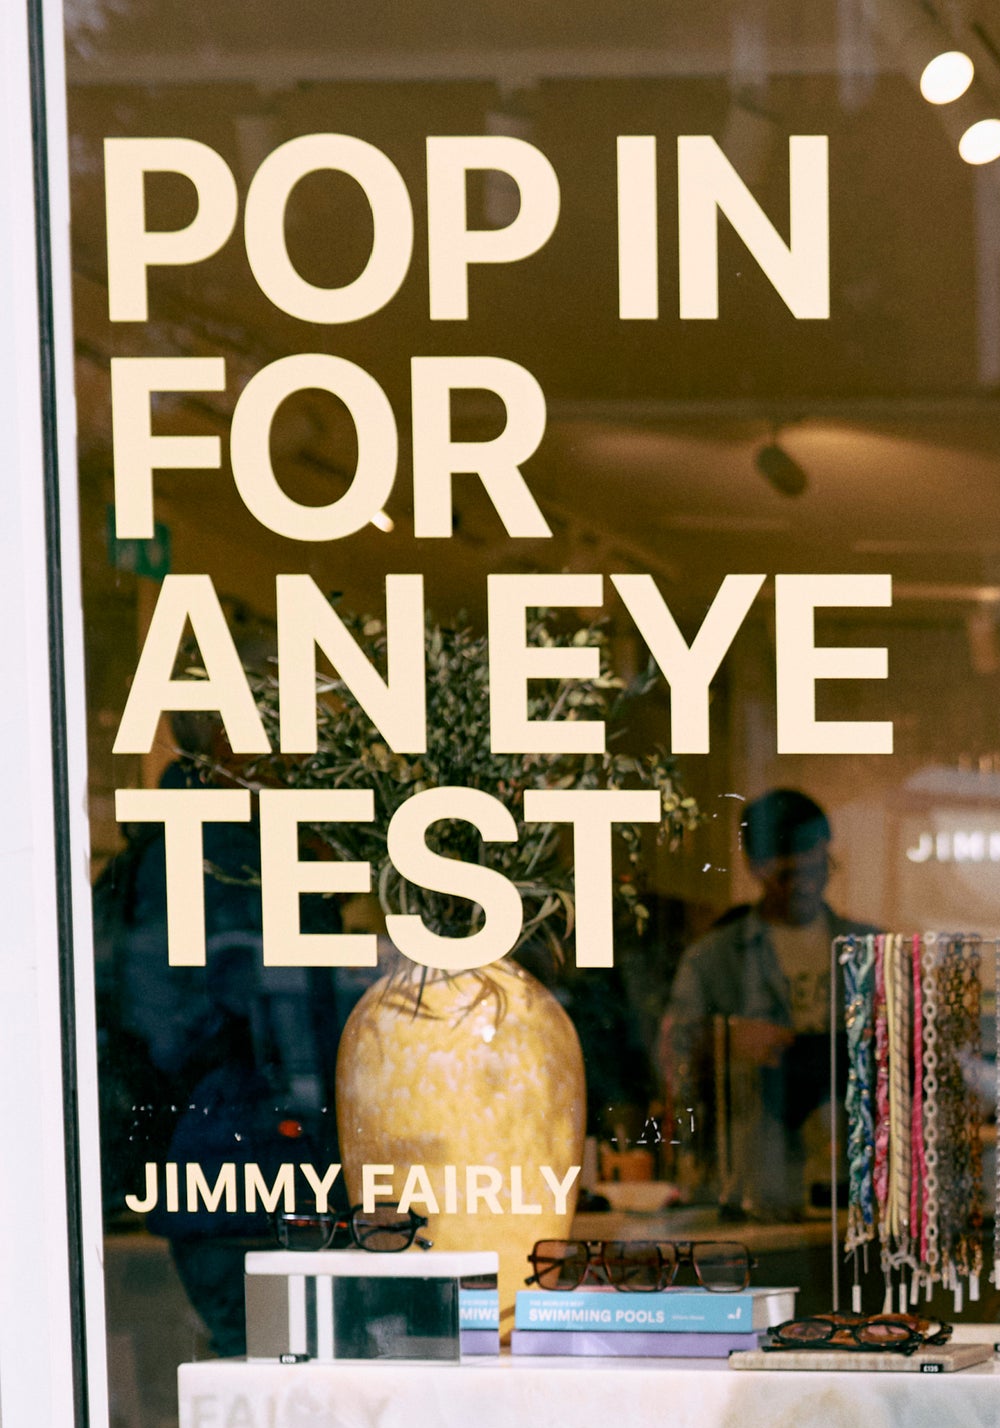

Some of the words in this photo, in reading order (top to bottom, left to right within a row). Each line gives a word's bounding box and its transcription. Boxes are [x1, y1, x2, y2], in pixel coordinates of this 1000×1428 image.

[104, 133, 560, 323] POP
[617, 135, 829, 319] IN
[111, 353, 552, 541] FOR
[112, 574, 427, 754] AN
[487, 574, 893, 754] EYE
[115, 787, 661, 971] TEST
[125, 1162, 342, 1213] JIMMY
[362, 1164, 582, 1215] FAIRLY
[529, 1309, 611, 1323] SWIMMING
[615, 1310, 665, 1323] POOLS
